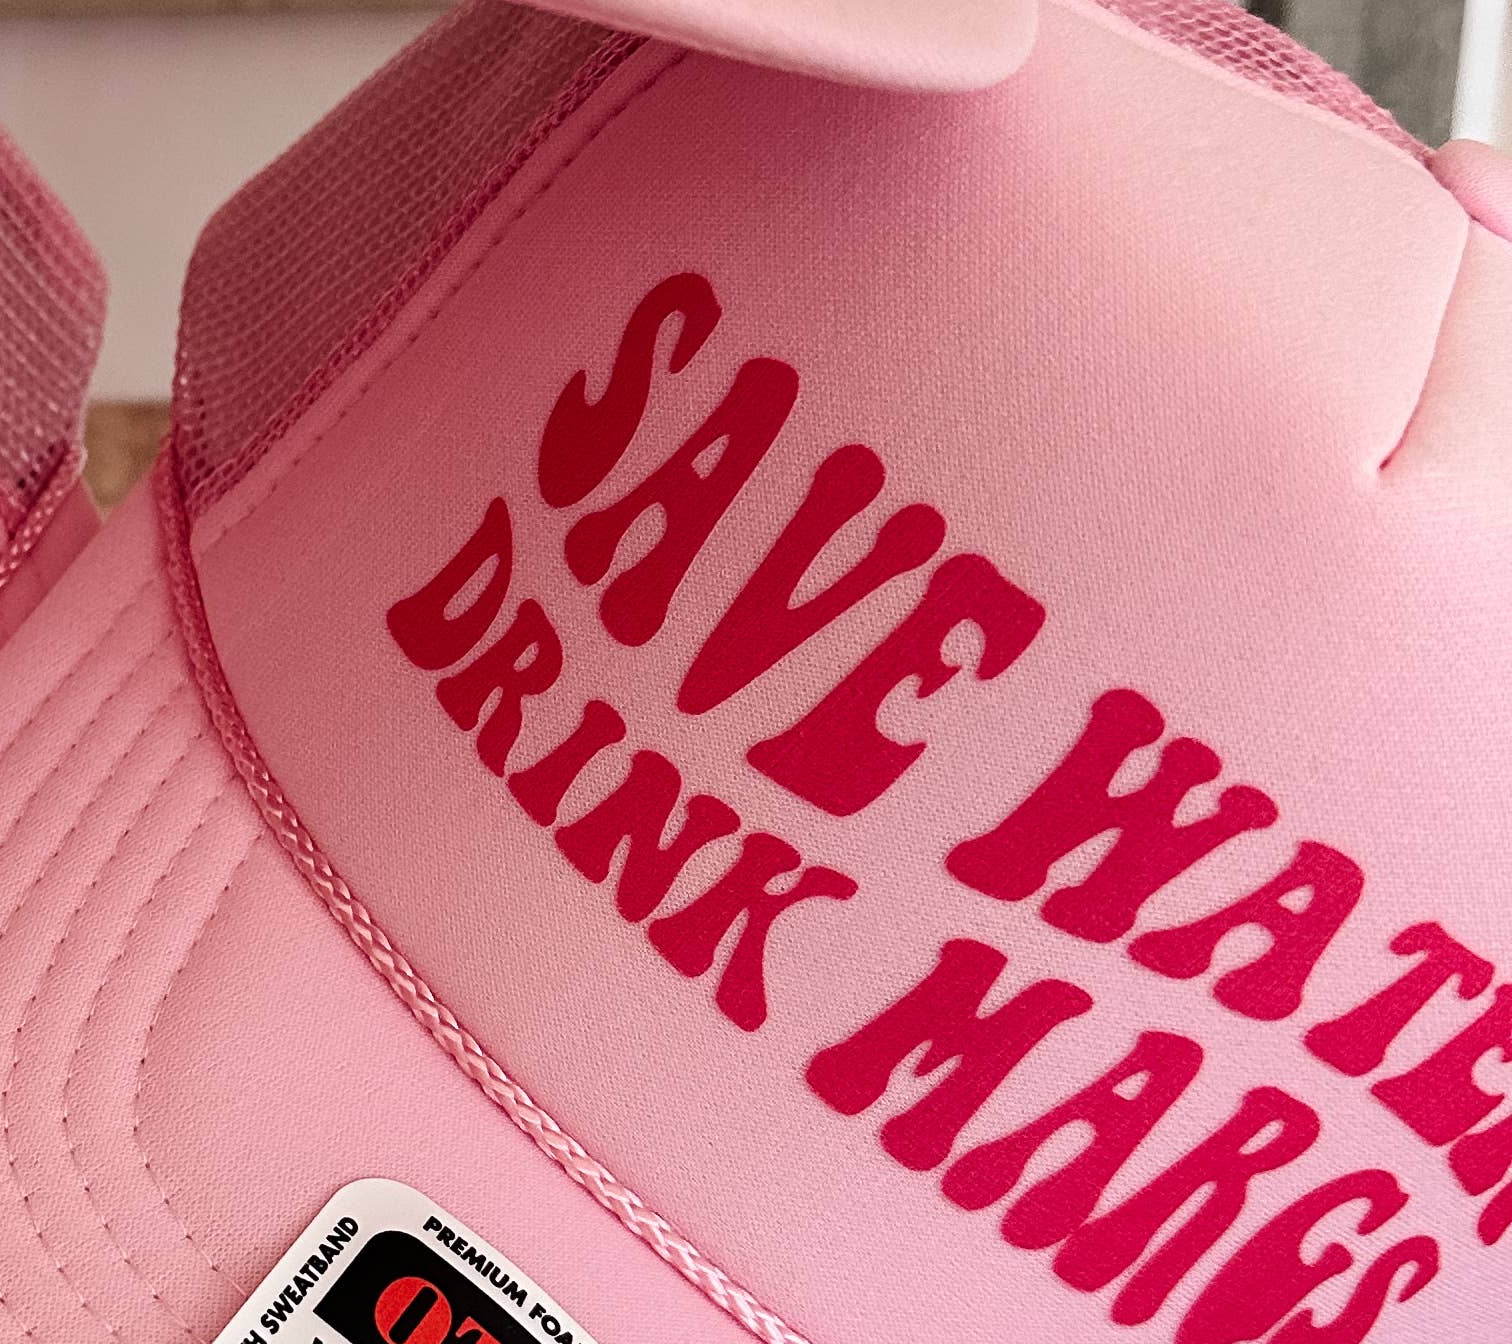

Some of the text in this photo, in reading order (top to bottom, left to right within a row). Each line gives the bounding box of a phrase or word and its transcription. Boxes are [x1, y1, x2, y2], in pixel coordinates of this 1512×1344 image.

[385, 496, 858, 1032] DRINK
[537, 272, 1512, 1246] SAVE WATE
[261, 1216, 360, 1335] SWEATBAND
[422, 1216, 528, 1309] PREMIUM
